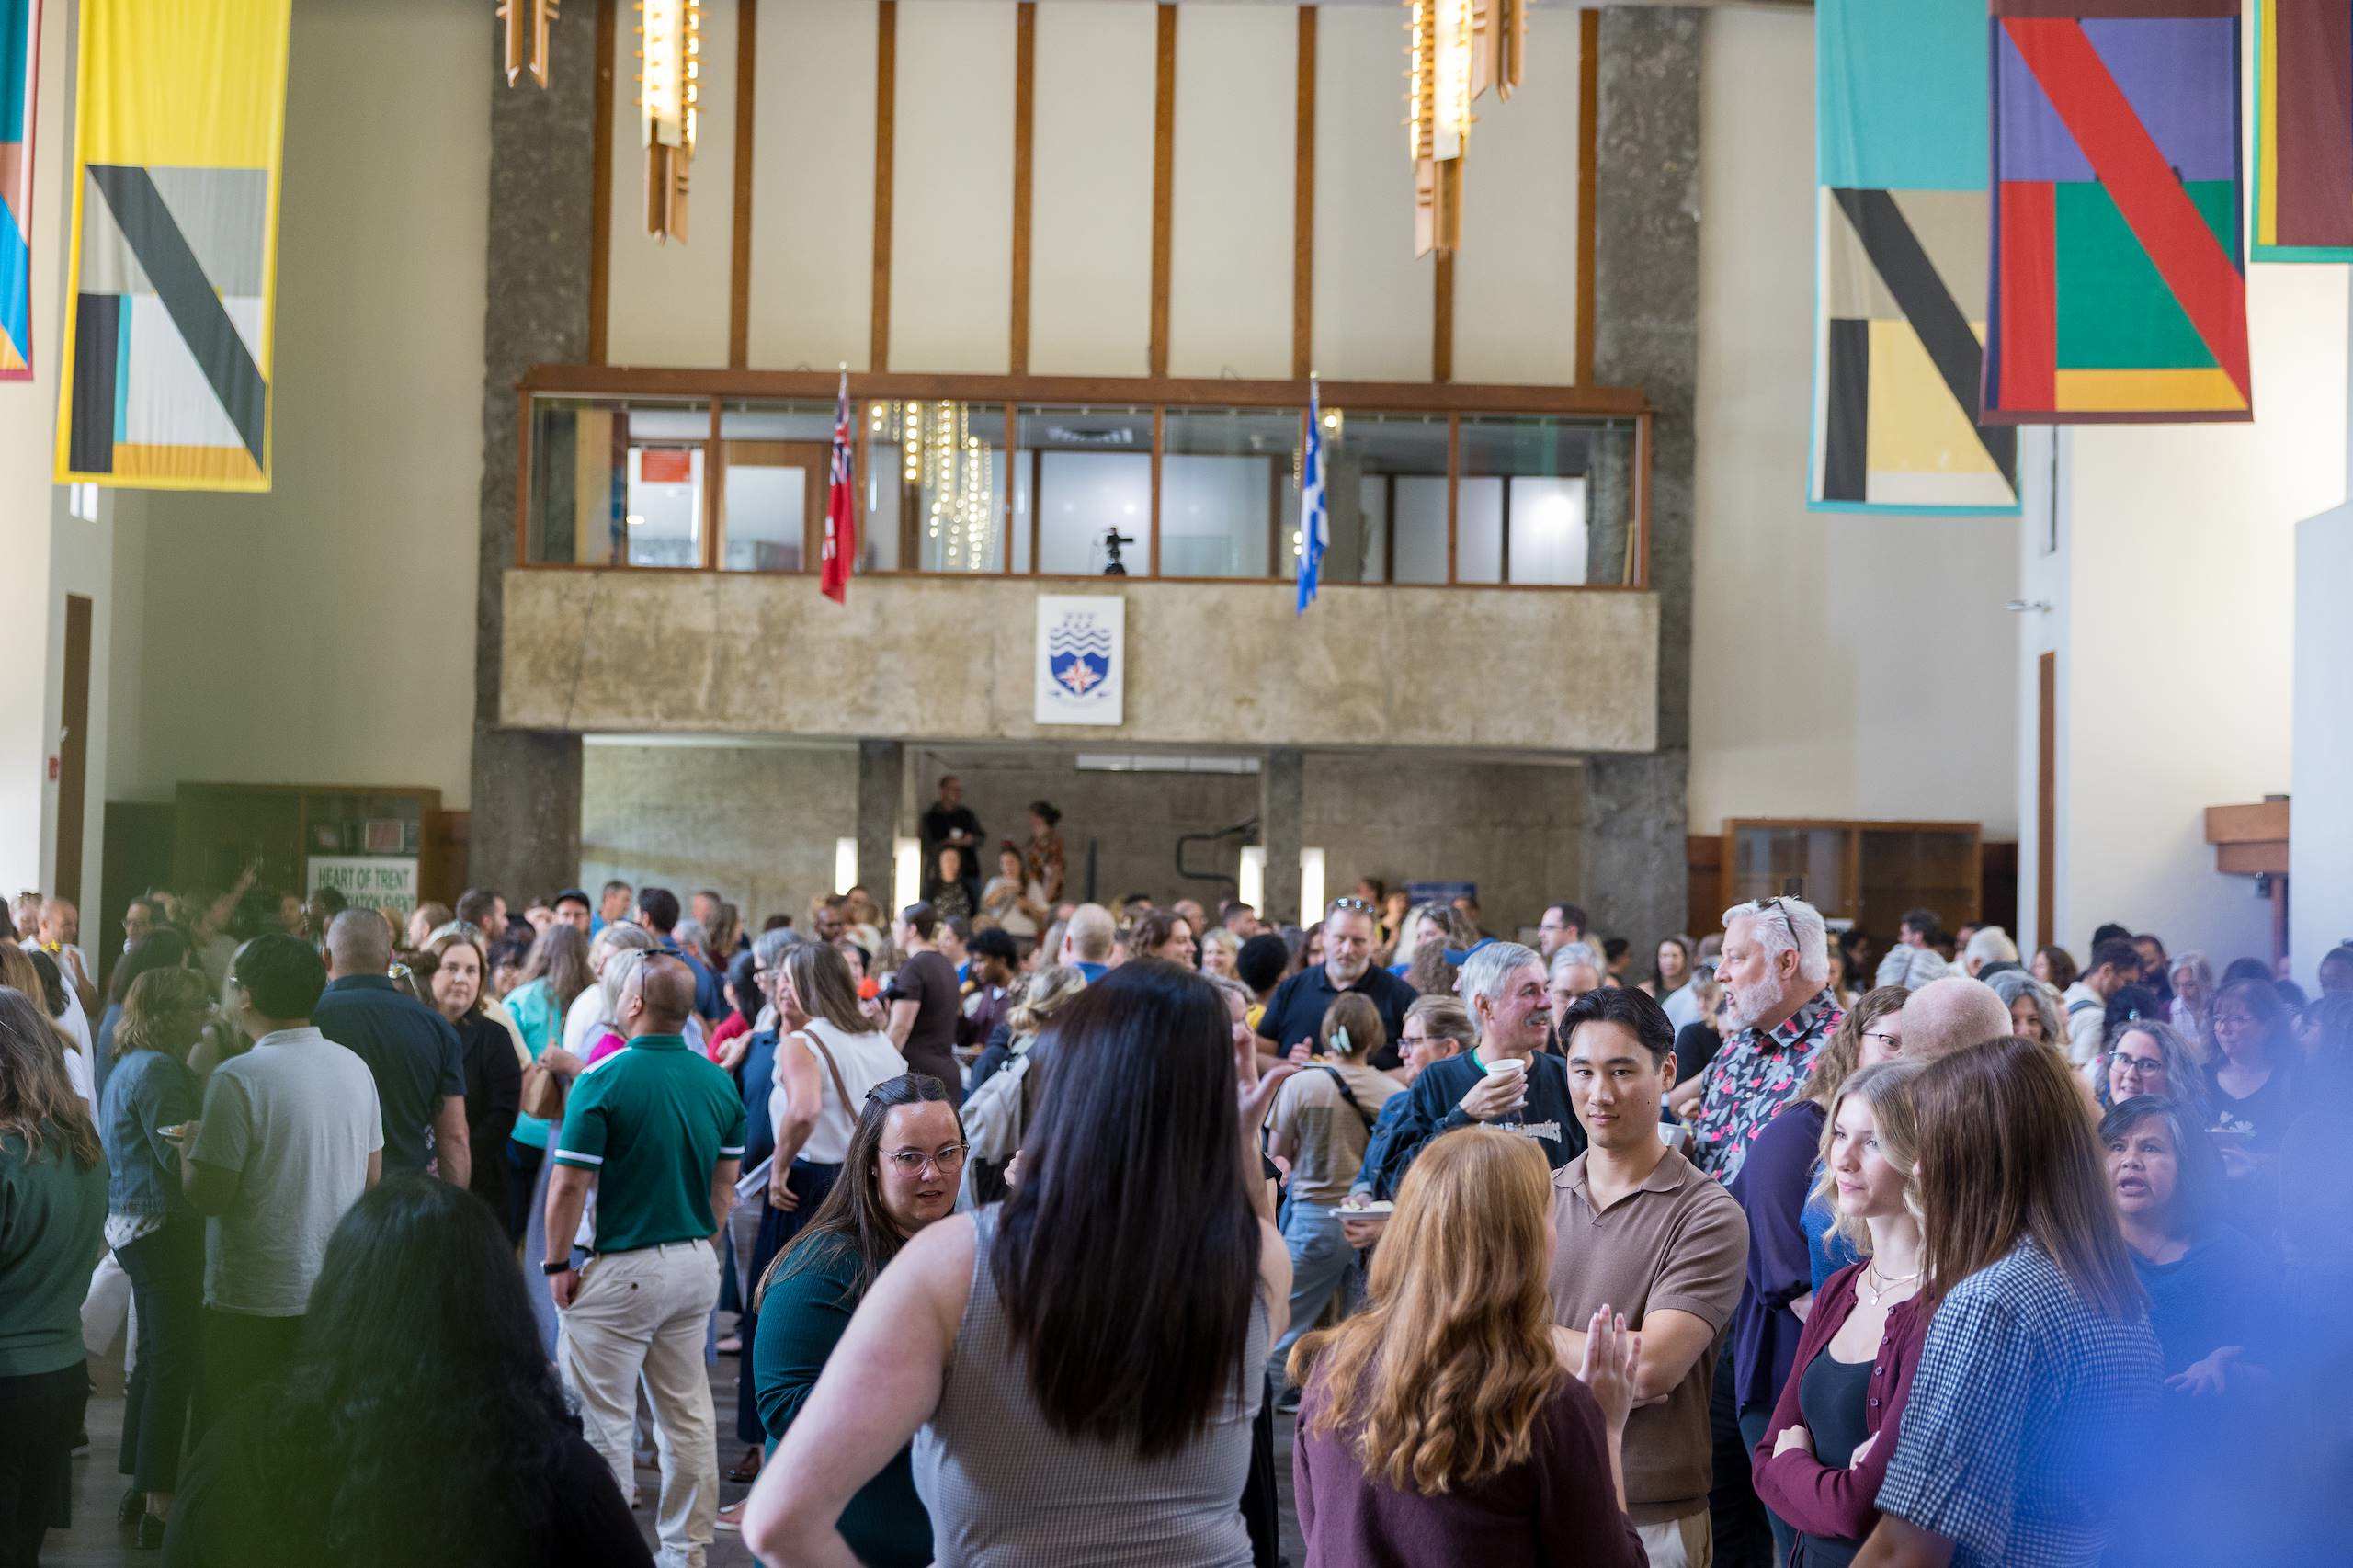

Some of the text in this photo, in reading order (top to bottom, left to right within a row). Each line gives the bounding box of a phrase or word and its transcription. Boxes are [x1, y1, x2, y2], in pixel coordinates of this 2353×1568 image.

[319, 867, 411, 889] HEART OF TRENT
